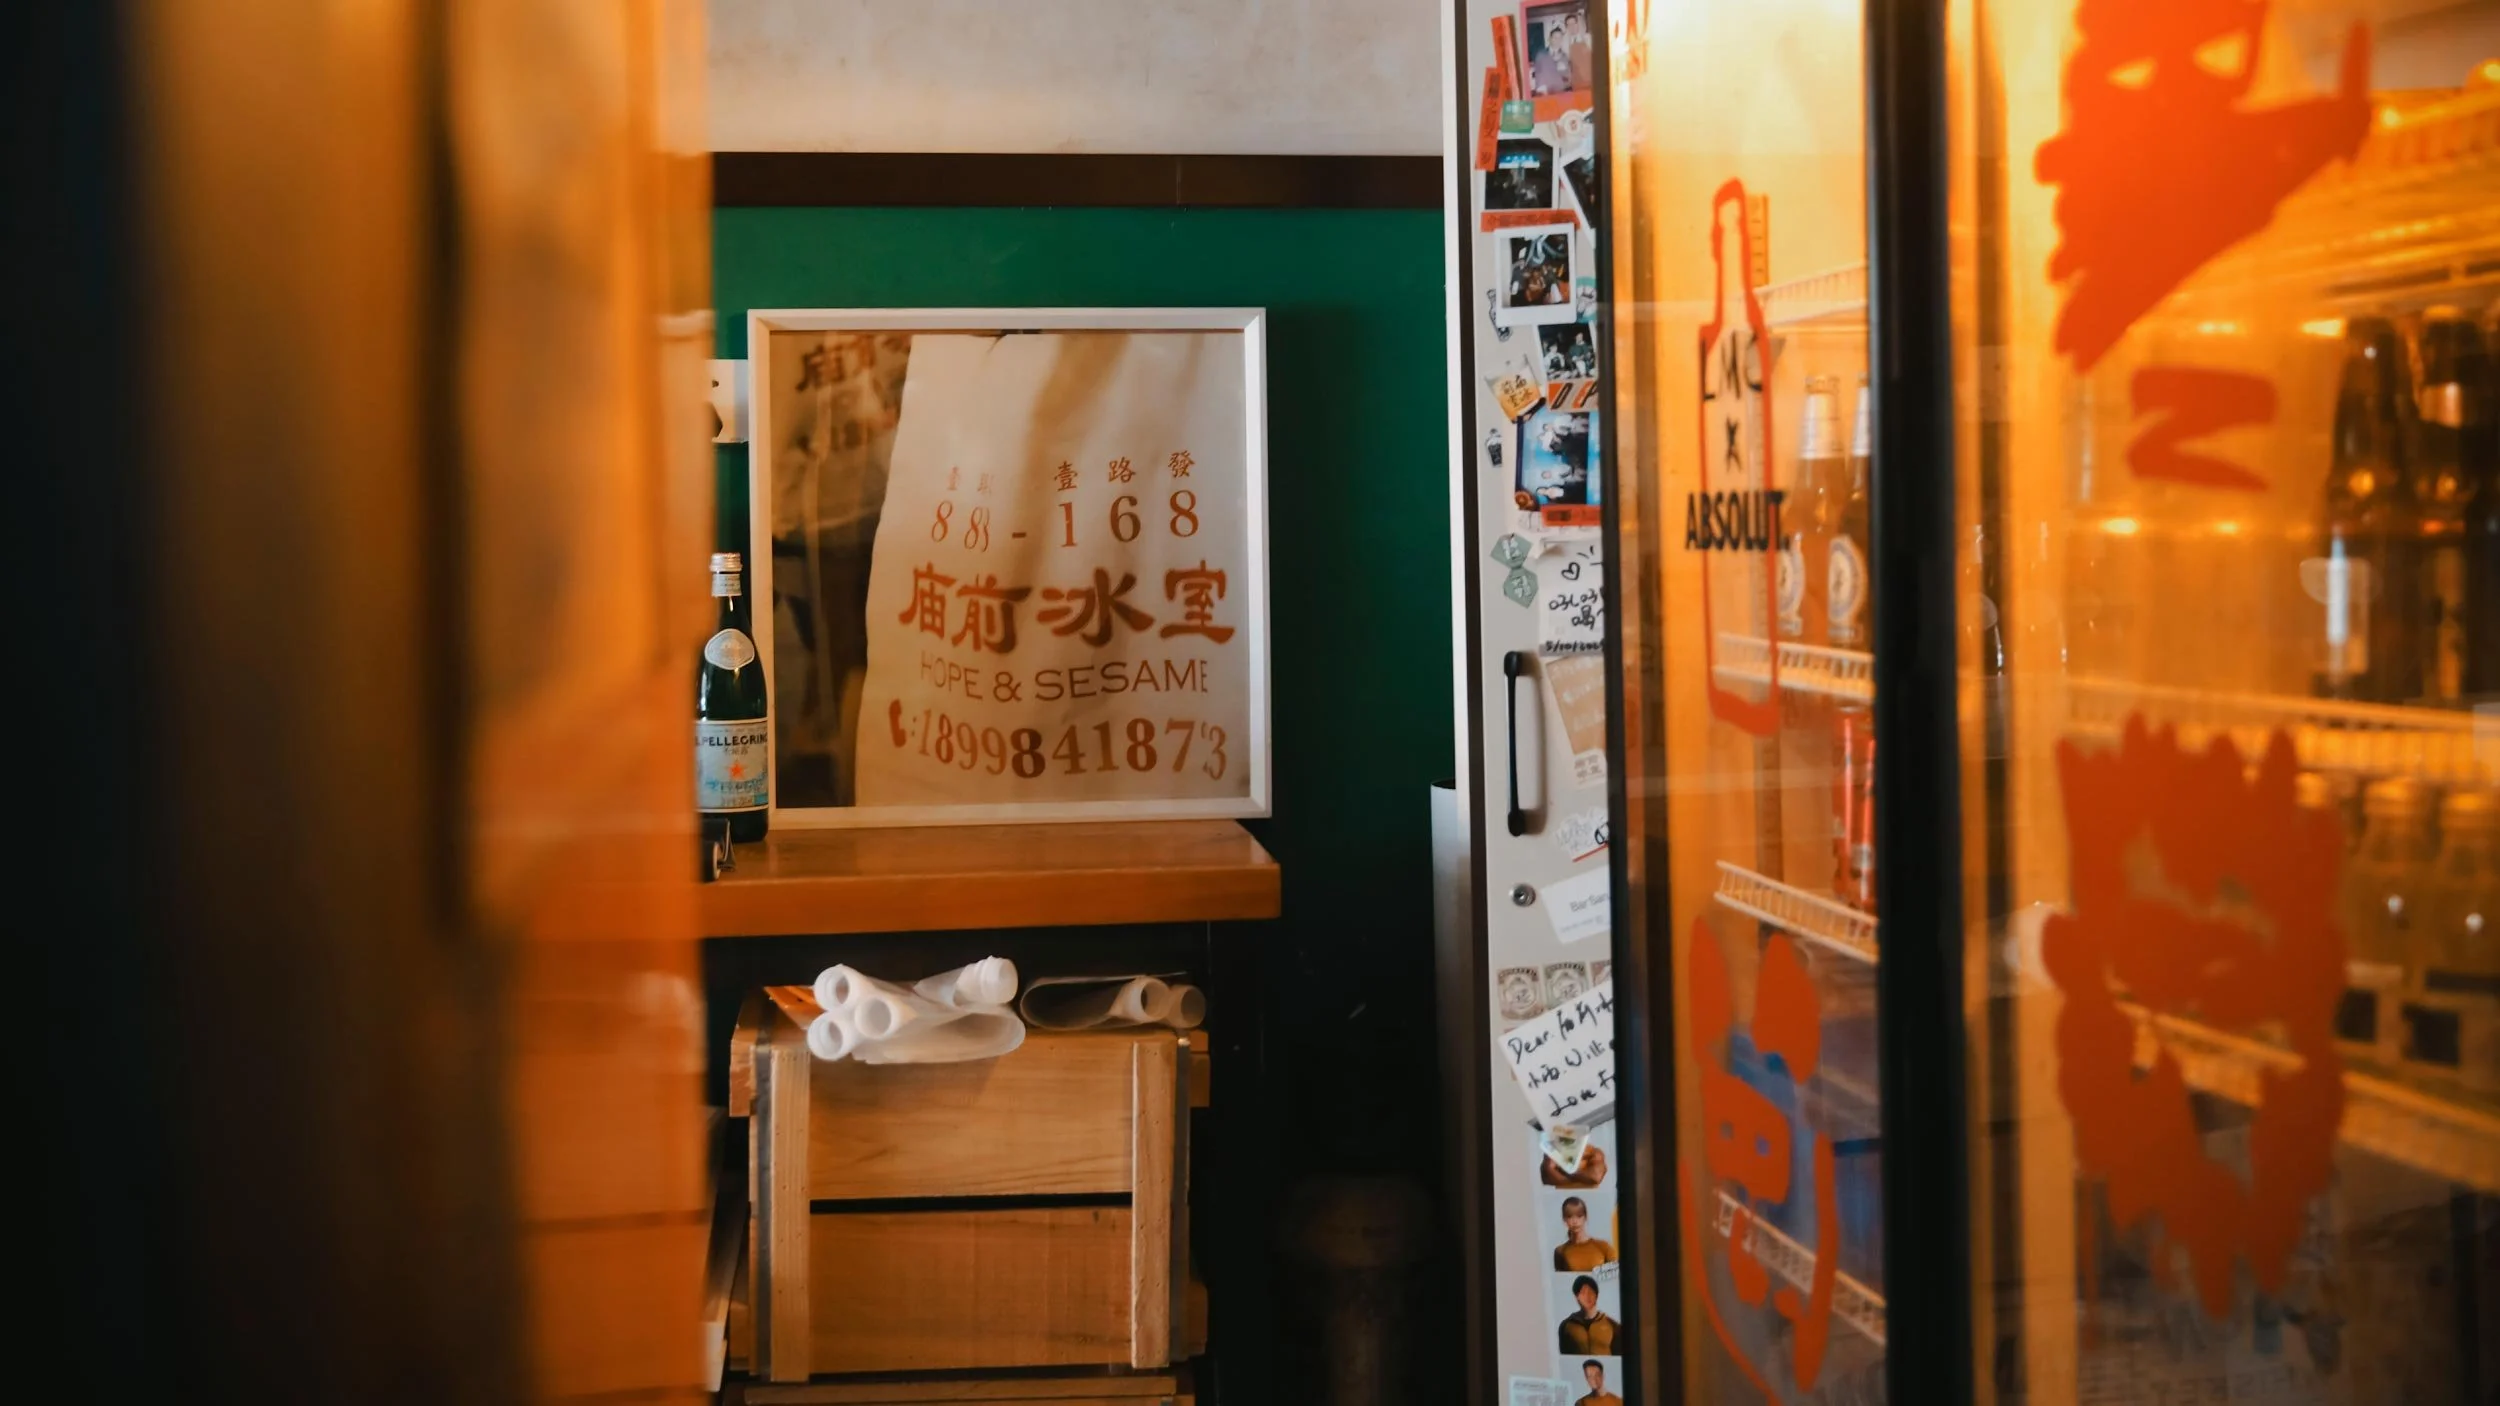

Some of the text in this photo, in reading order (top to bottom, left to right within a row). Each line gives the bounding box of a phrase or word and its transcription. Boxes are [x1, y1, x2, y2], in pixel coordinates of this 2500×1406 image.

[1700, 330, 1764, 402] LMC
[898, 560, 1236, 655] 庙前冰室
[920, 651, 1208, 703] HOPE & SESAME
